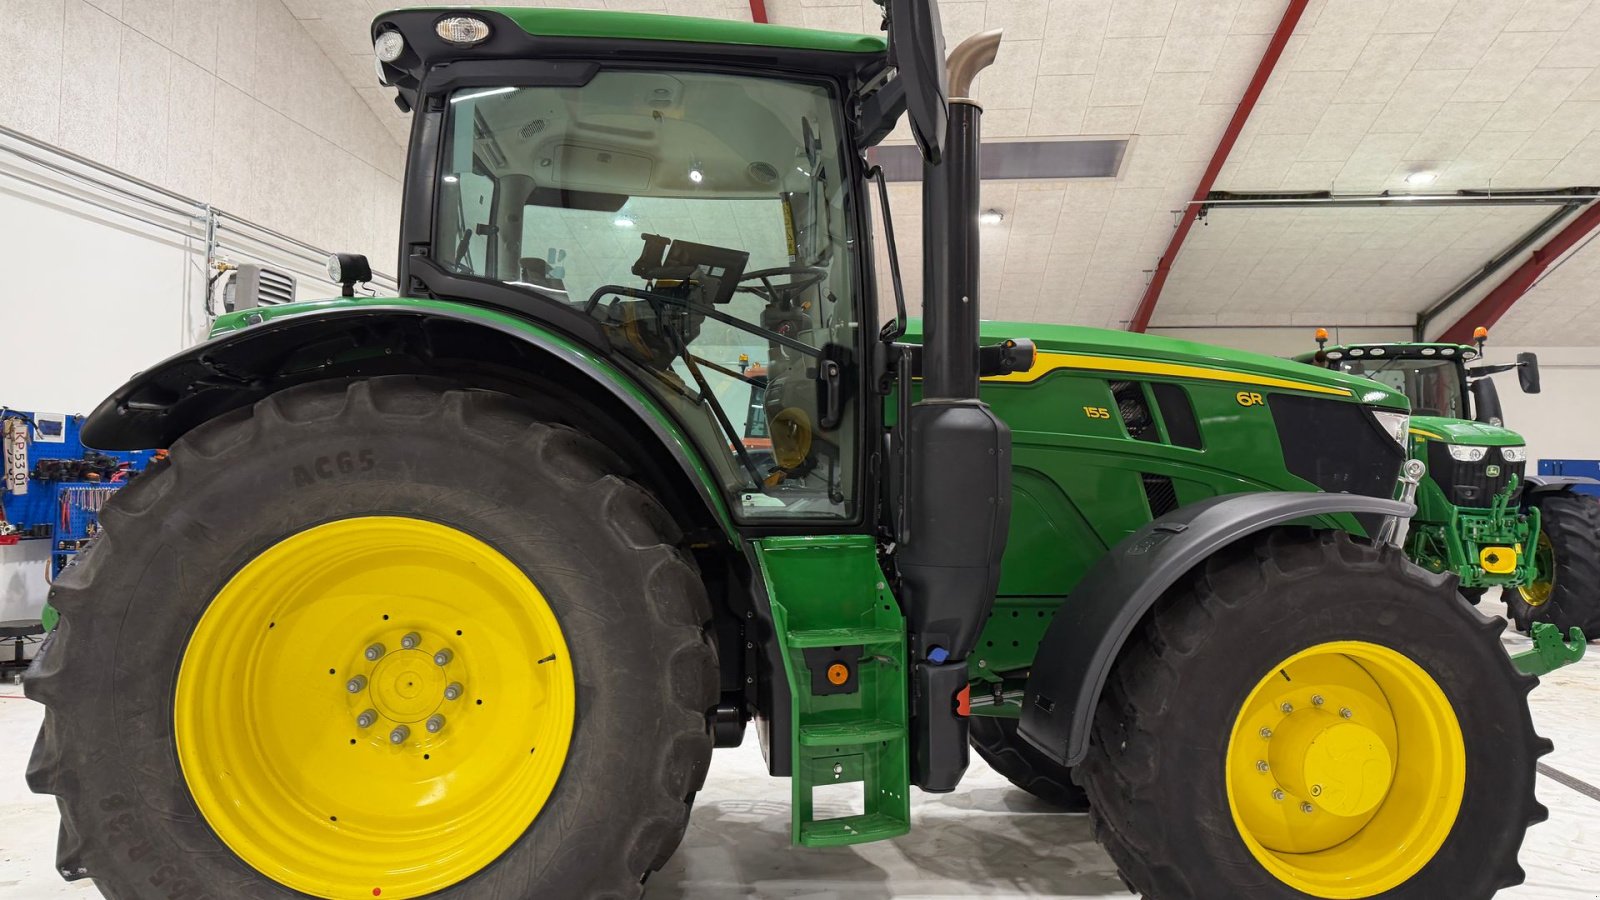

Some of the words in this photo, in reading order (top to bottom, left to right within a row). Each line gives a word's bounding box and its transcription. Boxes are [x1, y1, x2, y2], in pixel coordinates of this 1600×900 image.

[1236, 391, 1264, 407] 6R
[1083, 406, 1110, 419] 155
[15, 431, 25, 450] KP
[15, 453, 25, 469] 53
[292, 448, 375, 488] AC65
[15, 472, 26, 486] 01
